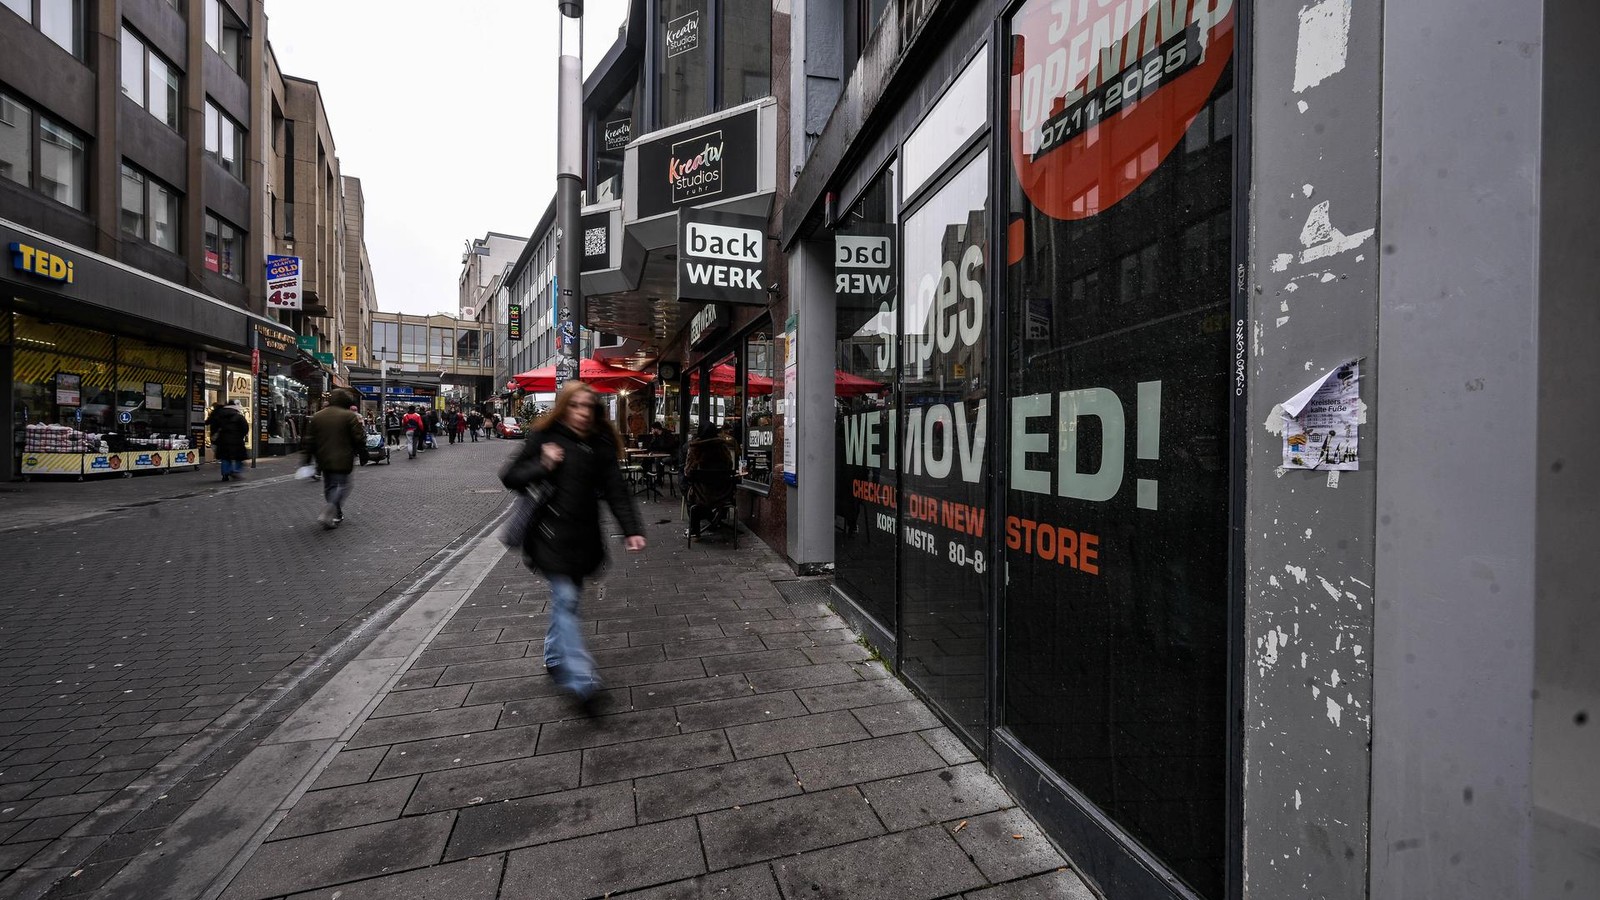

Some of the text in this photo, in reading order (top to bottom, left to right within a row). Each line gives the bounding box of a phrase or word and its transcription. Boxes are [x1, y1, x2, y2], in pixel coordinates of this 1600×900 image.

[667, 17, 699, 46] Kreativ
[671, 34, 696, 49] studios
[1040, 39, 1187, 151] 07.11.2025
[605, 123, 631, 142] Kreativ
[669, 141, 724, 184] Kreativ
[676, 170, 719, 190] studios
[686, 185, 708, 196] ruhr
[690, 227, 758, 258] back
[19, 243, 73, 284] TEDi
[271, 264, 298, 275] GOLD
[686, 263, 762, 290] WERK
[511, 306, 519, 335] BUTLERS
[844, 410, 881, 468] WE
[853, 479, 1099, 576] CHECK OU OUR NEW STORE
